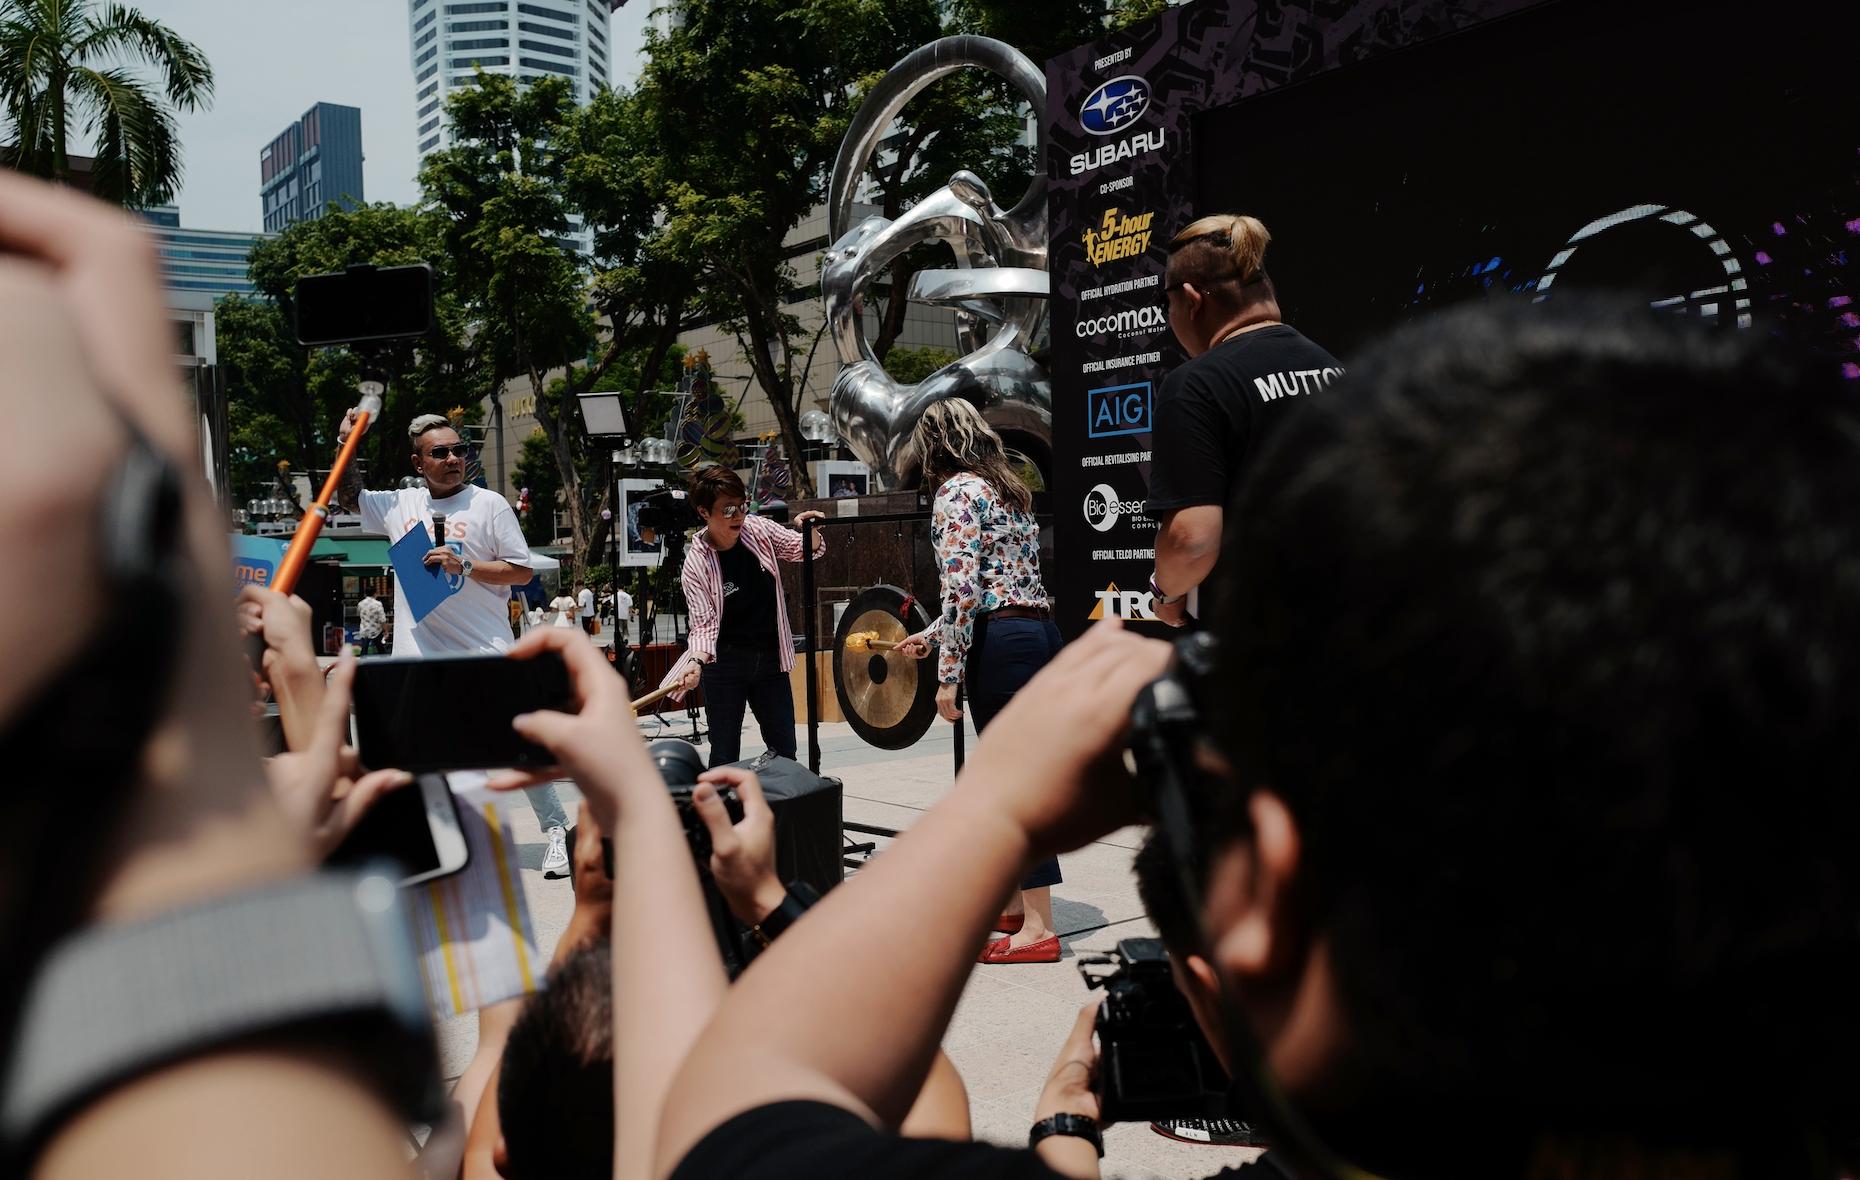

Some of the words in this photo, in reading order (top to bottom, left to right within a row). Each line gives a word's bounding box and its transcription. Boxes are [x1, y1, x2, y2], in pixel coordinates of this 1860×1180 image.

[1094, 50, 1124, 71] PRESENTED
[1124, 46, 1132, 59] BY
[1070, 128, 1165, 176] SUBARU
[1100, 175, 1133, 195] CO-SPONSOR
[1100, 207, 1154, 241] 5-hour
[1094, 230, 1152, 265] ENERGY
[1081, 287, 1103, 301] OFFICIAL
[1103, 280, 1133, 296] HYDRATION
[1133, 274, 1159, 290] PARTNER
[1076, 305, 1166, 338] cocomax
[1117, 330, 1146, 339] Coconut
[1082, 360, 1106, 374] OFFICIAL
[1105, 355, 1136, 370] INSURANCE
[1135, 351, 1161, 365] PARTNER
[1253, 366, 1346, 402] MUTTO
[1095, 393, 1144, 428] AIG
[1081, 456, 1105, 467] OFFICIAL
[1104, 452, 1140, 465] REVITALISING
[1092, 549, 1115, 561] OFFICIAL
[1115, 549, 1133, 560] TELCO
